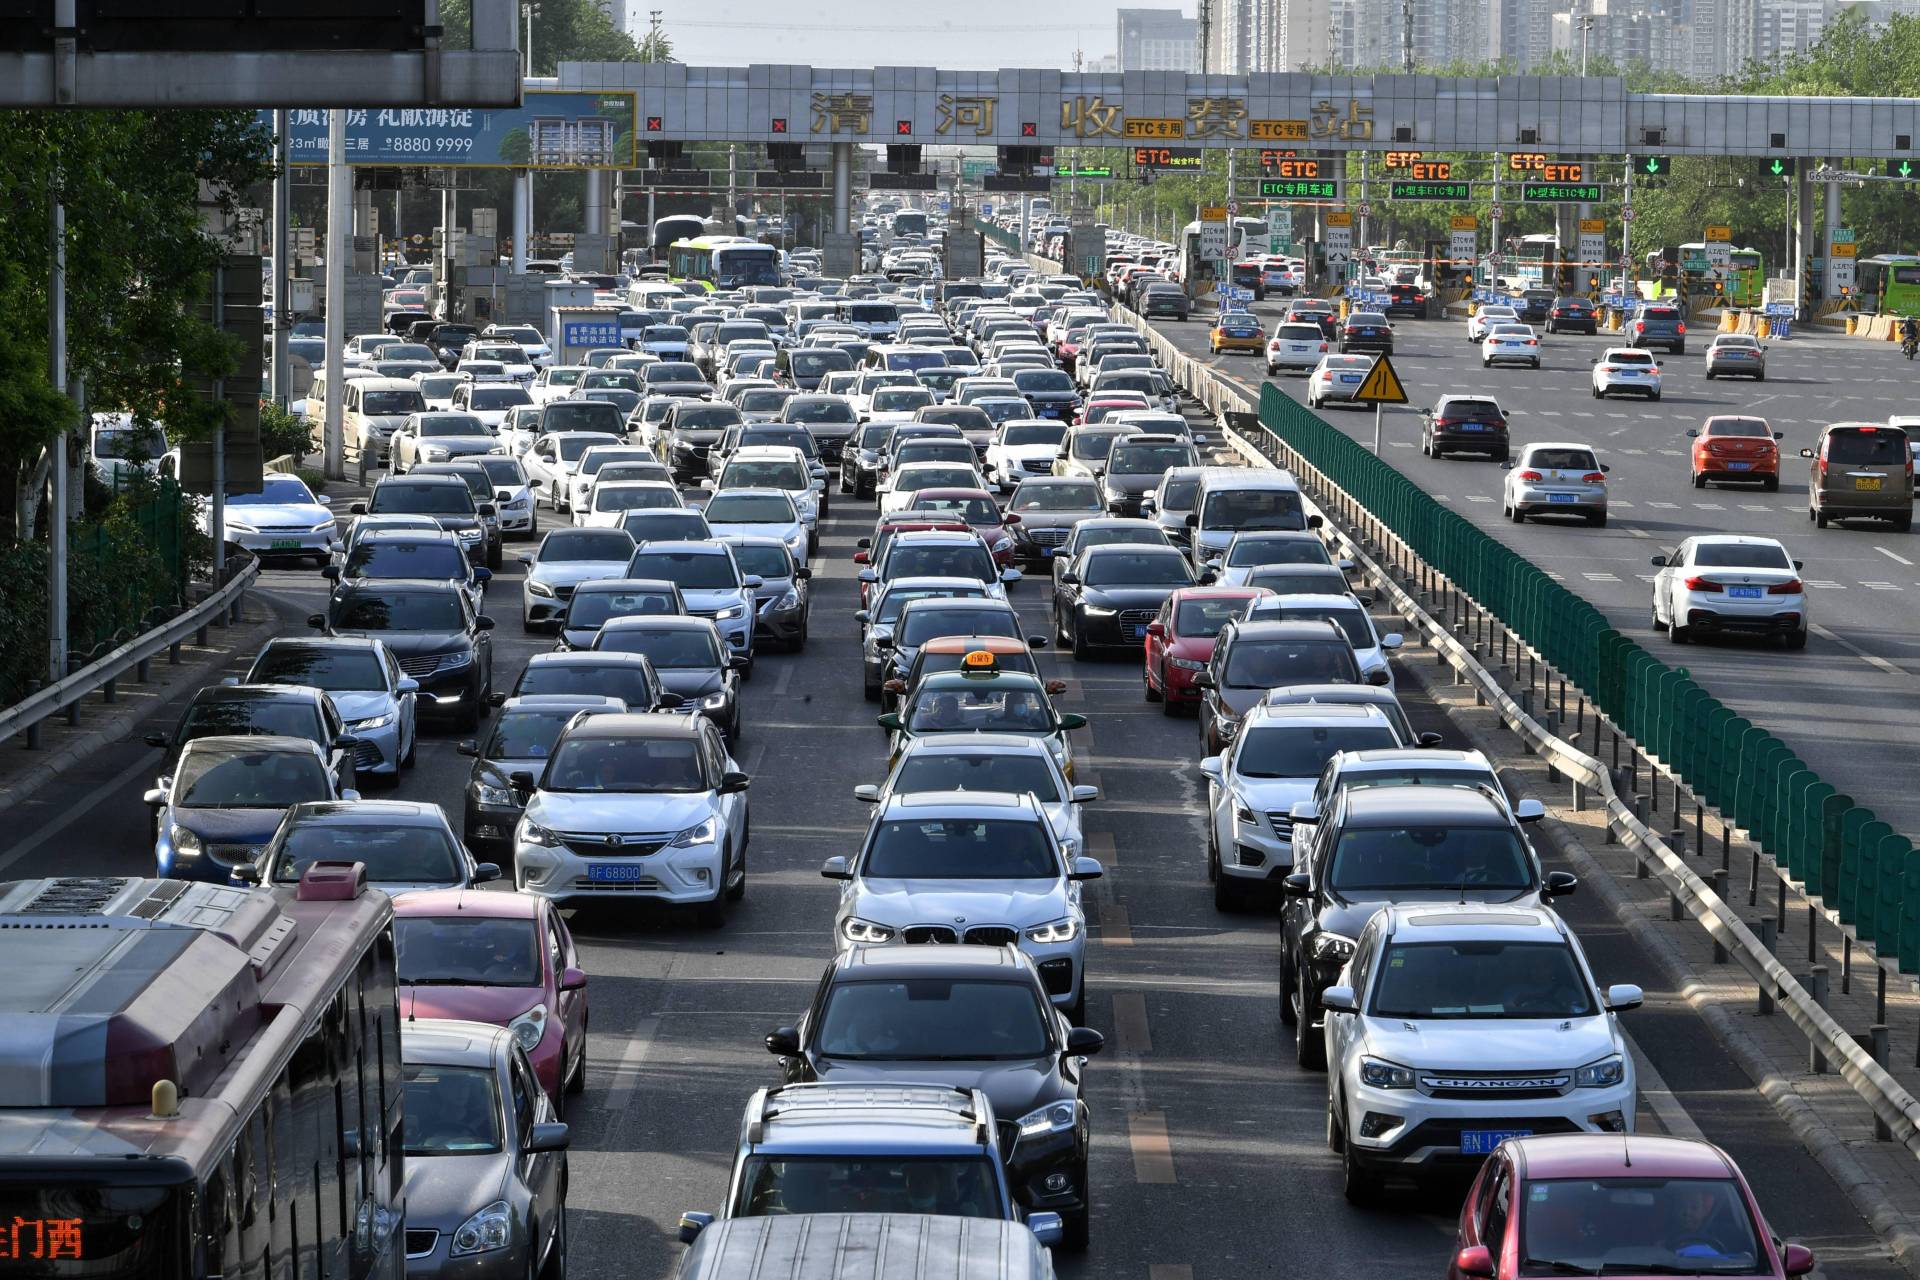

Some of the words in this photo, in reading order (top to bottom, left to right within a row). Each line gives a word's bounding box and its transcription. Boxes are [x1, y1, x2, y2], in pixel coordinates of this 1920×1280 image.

[1126, 121, 1182, 135] ETC专用
[1251, 122, 1307, 136] ETC专用
[393, 137, 431, 152] 8880
[435, 137, 473, 152] 9999
[1135, 150, 1170, 165] ETC
[1280, 161, 1317, 176] ETC
[1413, 164, 1450, 180] ETC
[1545, 165, 1582, 181] ETC
[1263, 183, 1334, 195] ETC专用车道
[1394, 186, 1466, 197] 小型车ETC专用
[1526, 187, 1598, 199] 小型车ETC专用
[1436, 1079, 1555, 1087] CHANGAN
